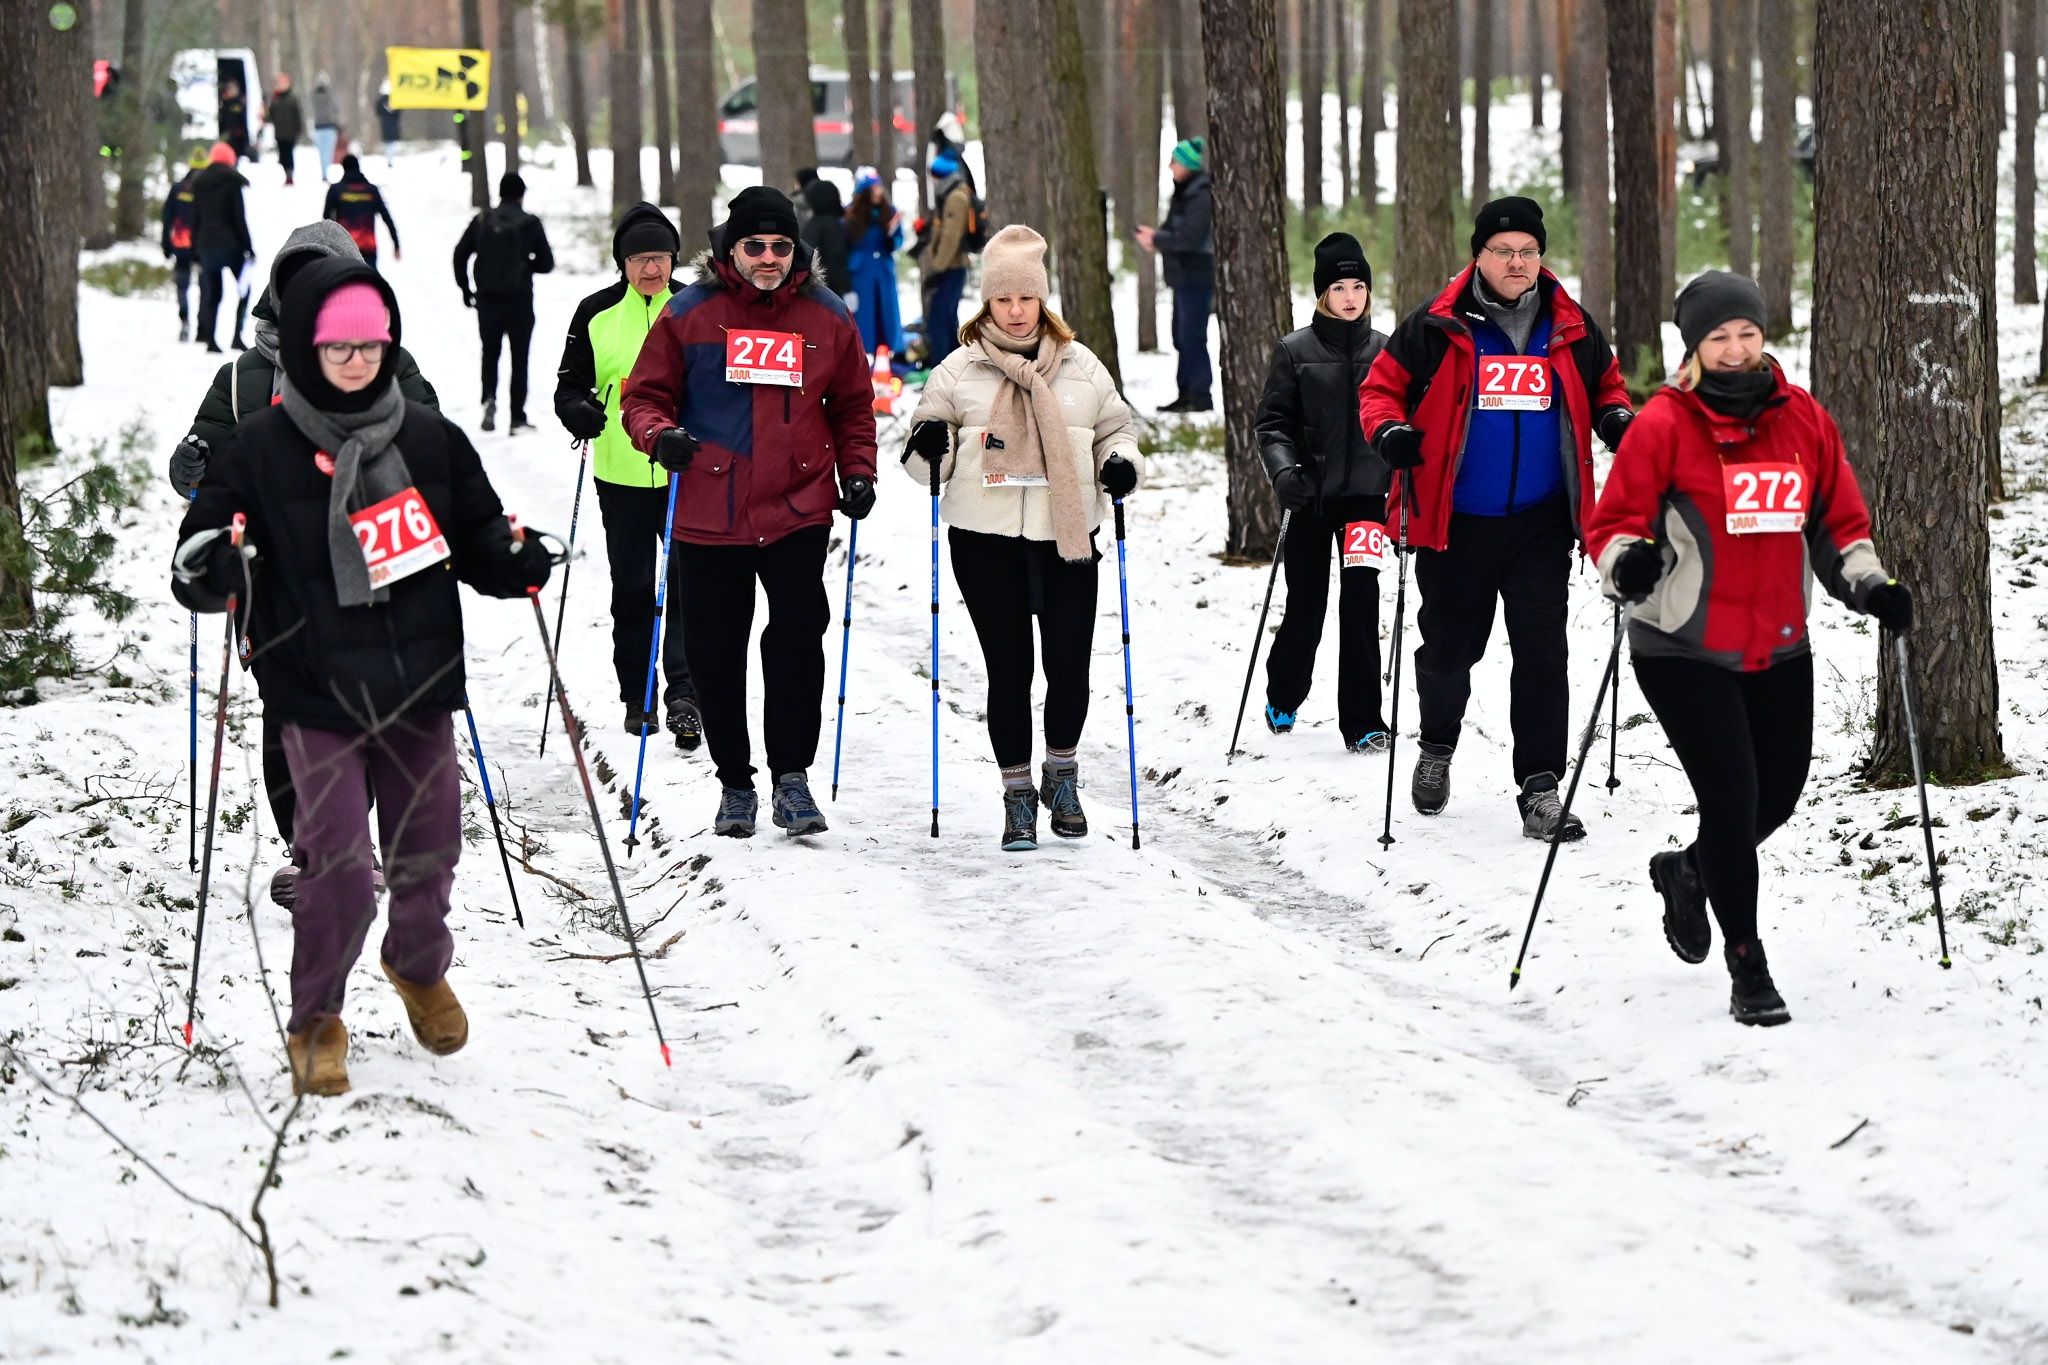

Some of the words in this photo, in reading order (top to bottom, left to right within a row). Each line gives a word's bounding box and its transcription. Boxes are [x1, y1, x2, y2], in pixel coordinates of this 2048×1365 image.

[733, 336, 797, 369] 274
[1484, 362, 1546, 393] 273
[1732, 471, 1802, 511] 272
[353, 499, 432, 564] 276
